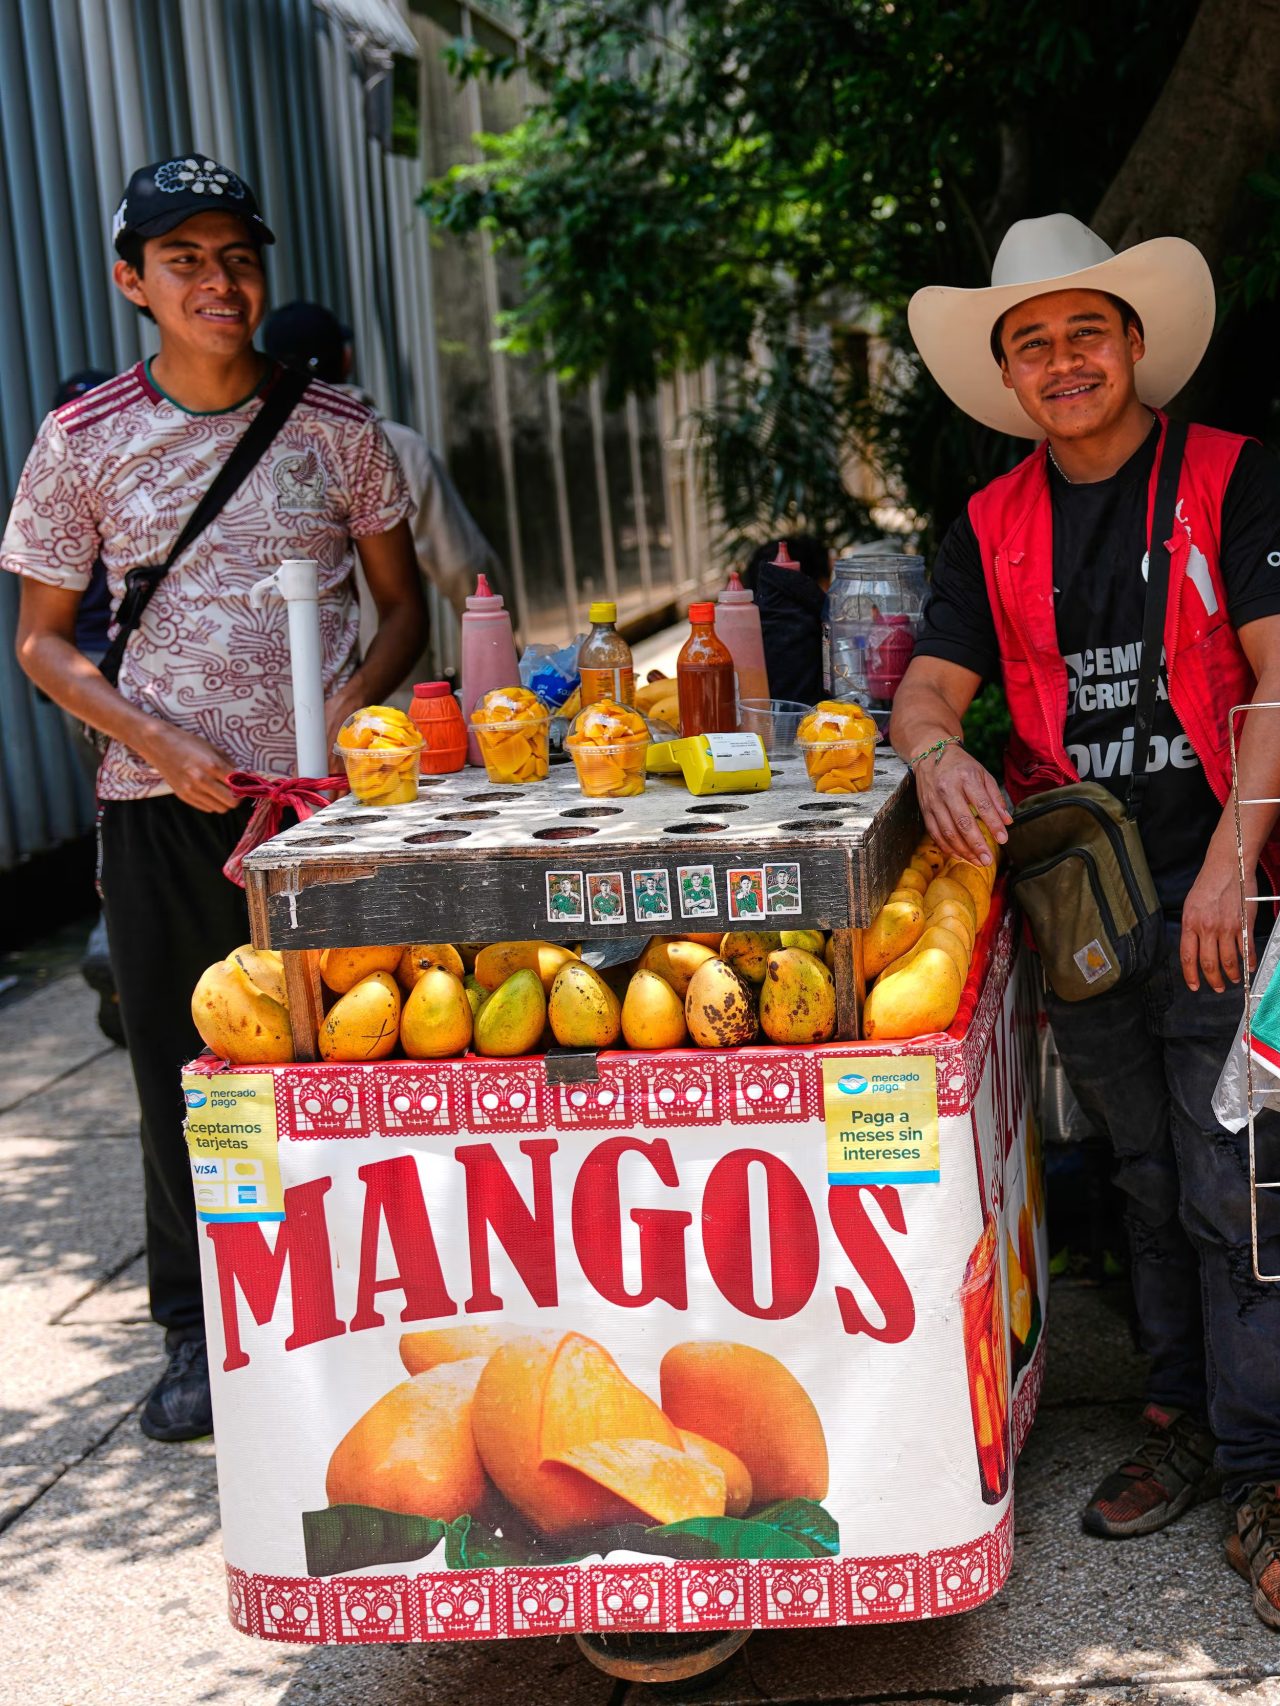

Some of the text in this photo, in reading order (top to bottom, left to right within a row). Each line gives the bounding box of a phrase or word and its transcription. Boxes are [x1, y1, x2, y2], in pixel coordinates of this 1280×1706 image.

[871, 1073, 920, 1083] mercado
[210, 1089, 256, 1098] mercado
[872, 1083, 899, 1094] pago
[211, 1098, 237, 1108] pago
[851, 1110, 910, 1127] Paga a
[839, 1127, 923, 1143] meses sin
[195, 1136, 249, 1150] tarjetas
[843, 1146, 921, 1161] intereses
[193, 1164, 218, 1175] VISA
[205, 1135, 917, 1373] MANGOS
